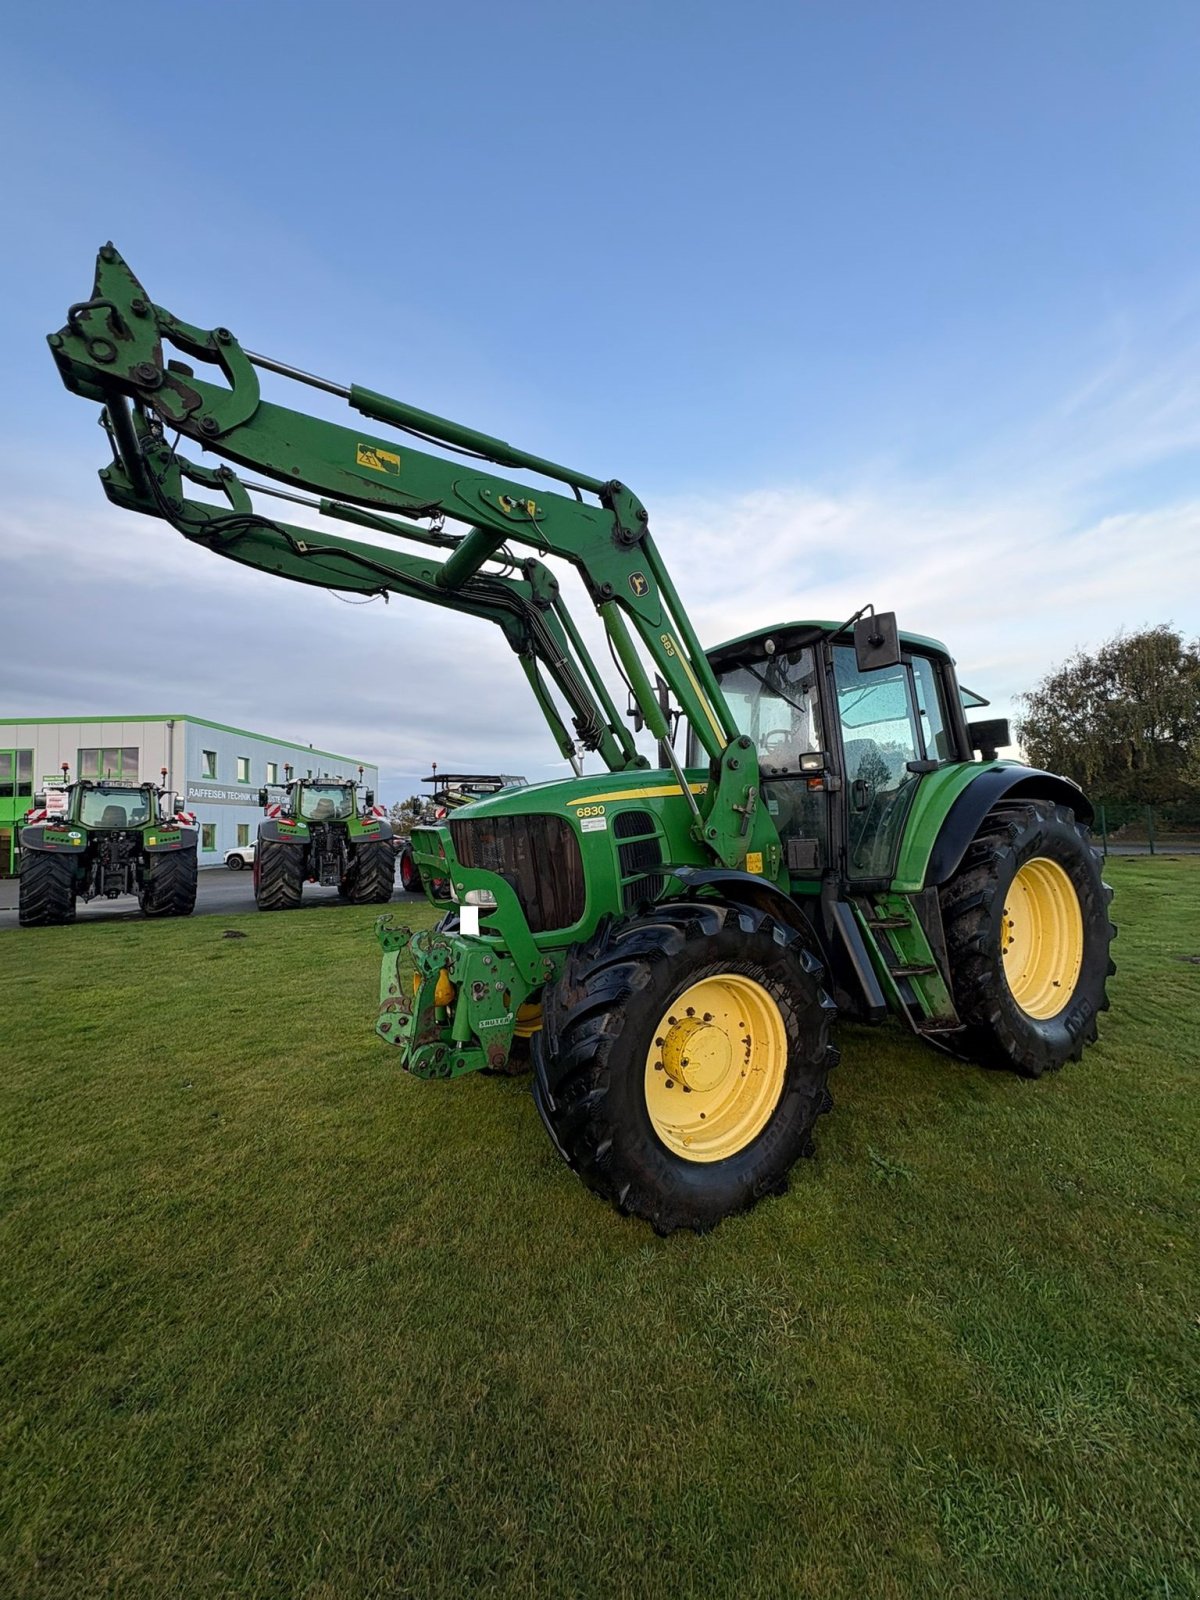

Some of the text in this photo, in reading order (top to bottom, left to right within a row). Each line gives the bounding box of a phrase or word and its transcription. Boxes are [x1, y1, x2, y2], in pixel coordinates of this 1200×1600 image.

[189, 787, 226, 799] RAIFFEISEN
[227, 791, 251, 802] TECHNIK
[576, 805, 605, 817] 6830
